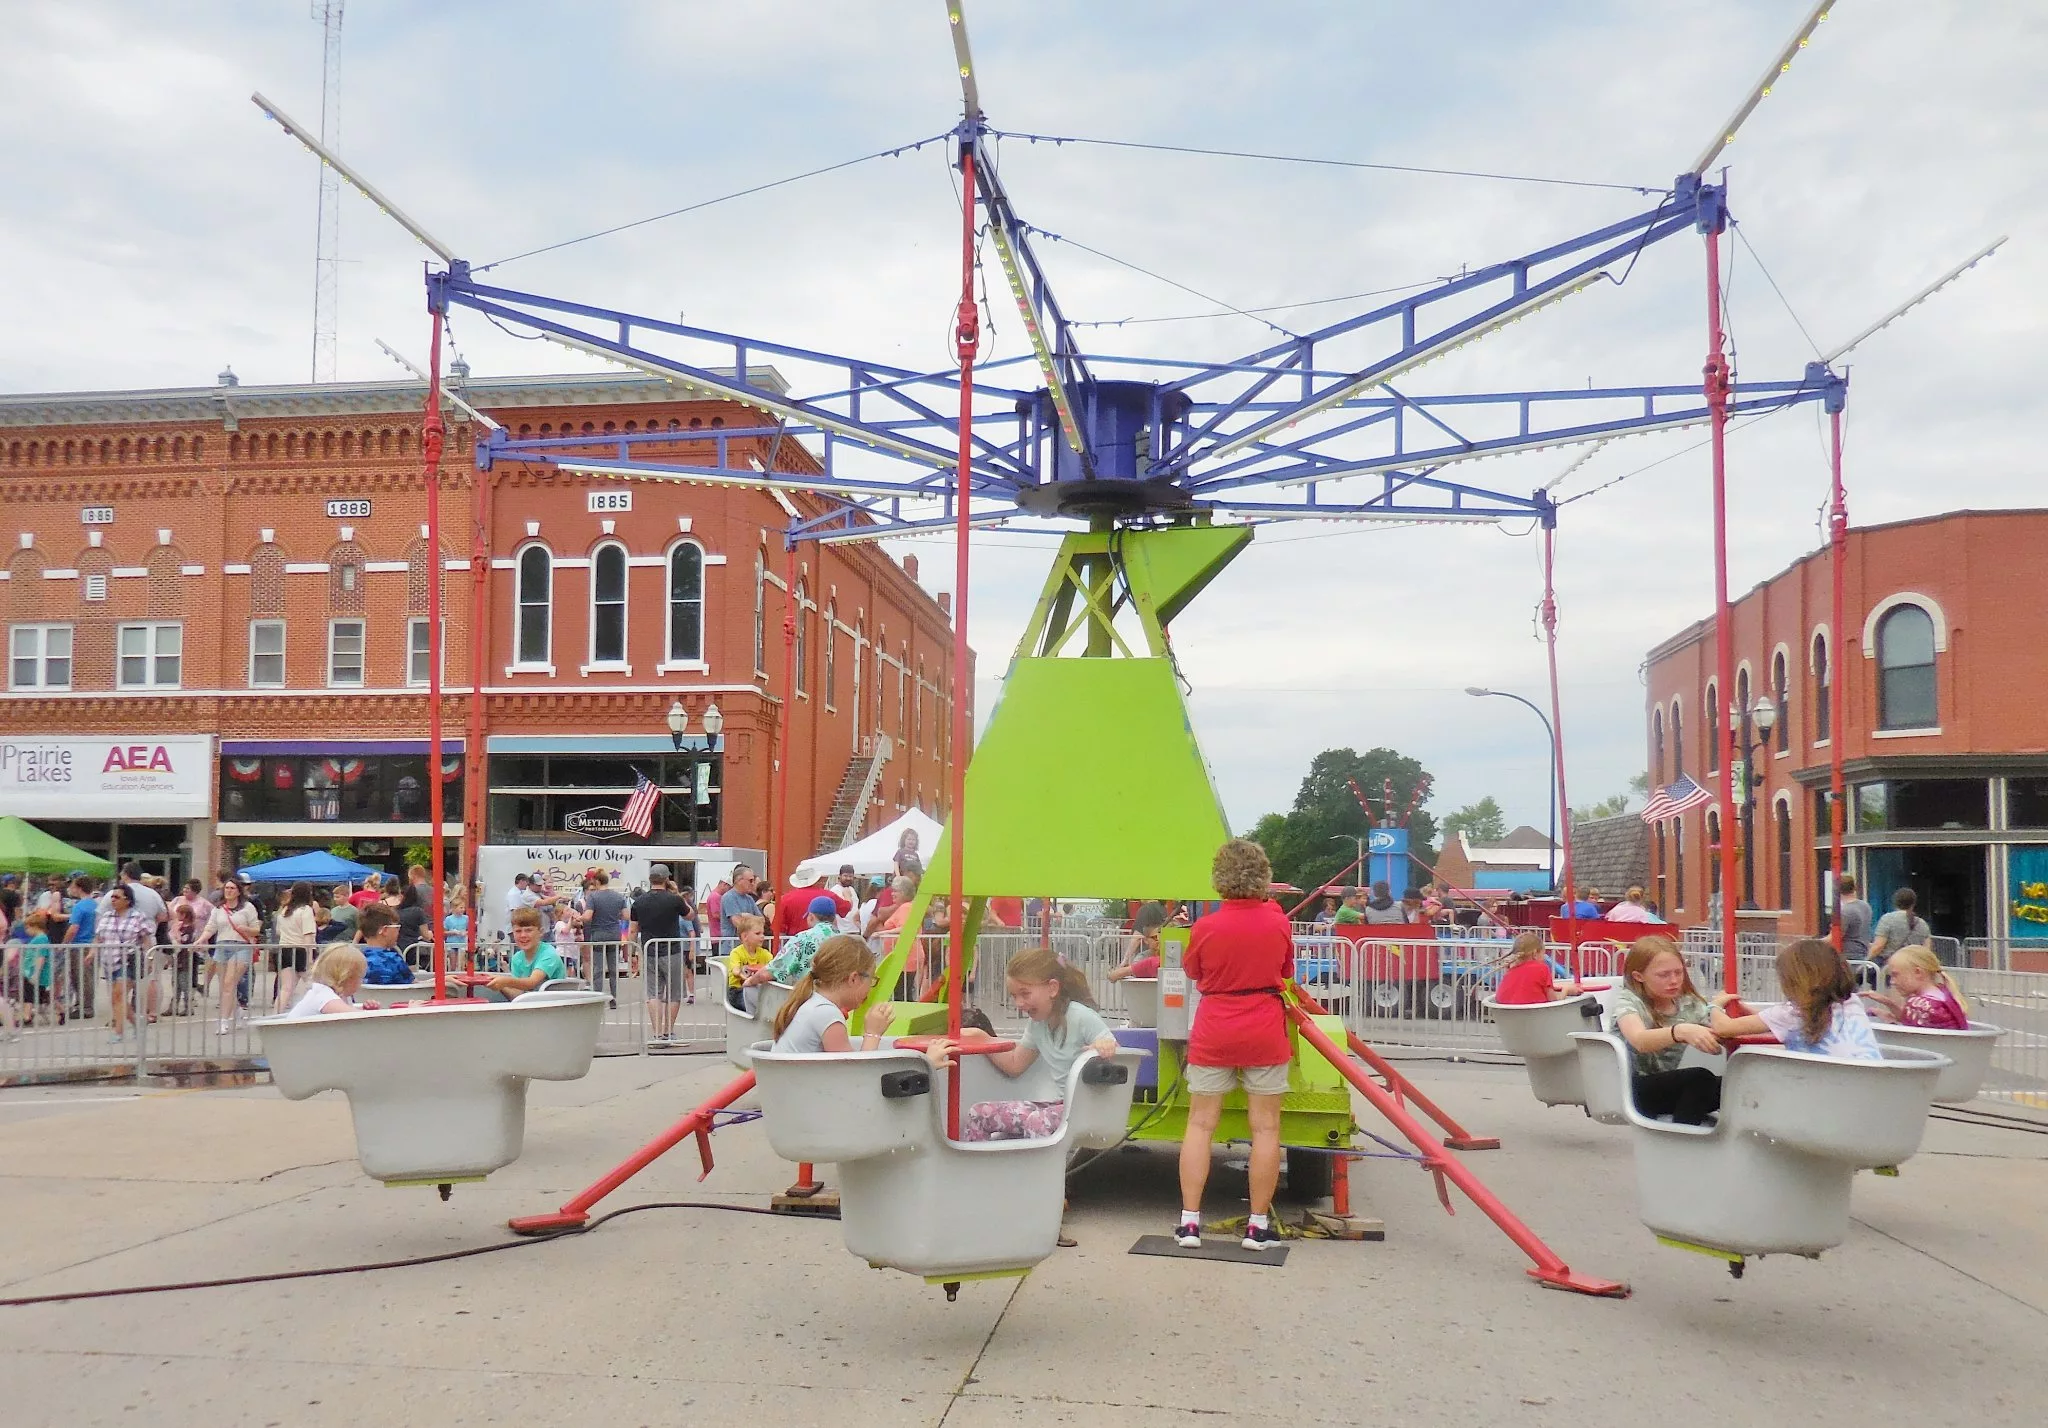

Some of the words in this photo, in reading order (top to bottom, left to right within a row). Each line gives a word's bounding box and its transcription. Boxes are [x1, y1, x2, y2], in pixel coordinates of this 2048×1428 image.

[330, 502, 368, 515] 1888
[591, 494, 628, 509] 1885
[3, 744, 72, 769] Prairie
[102, 745, 174, 773] AEA
[17, 766, 72, 782] Lakes
[139, 783, 174, 791] Agencies
[527, 848, 542, 859] We
[549, 848, 572, 862] Stop
[578, 848, 600, 860] YOU
[605, 849, 634, 863] Shop
